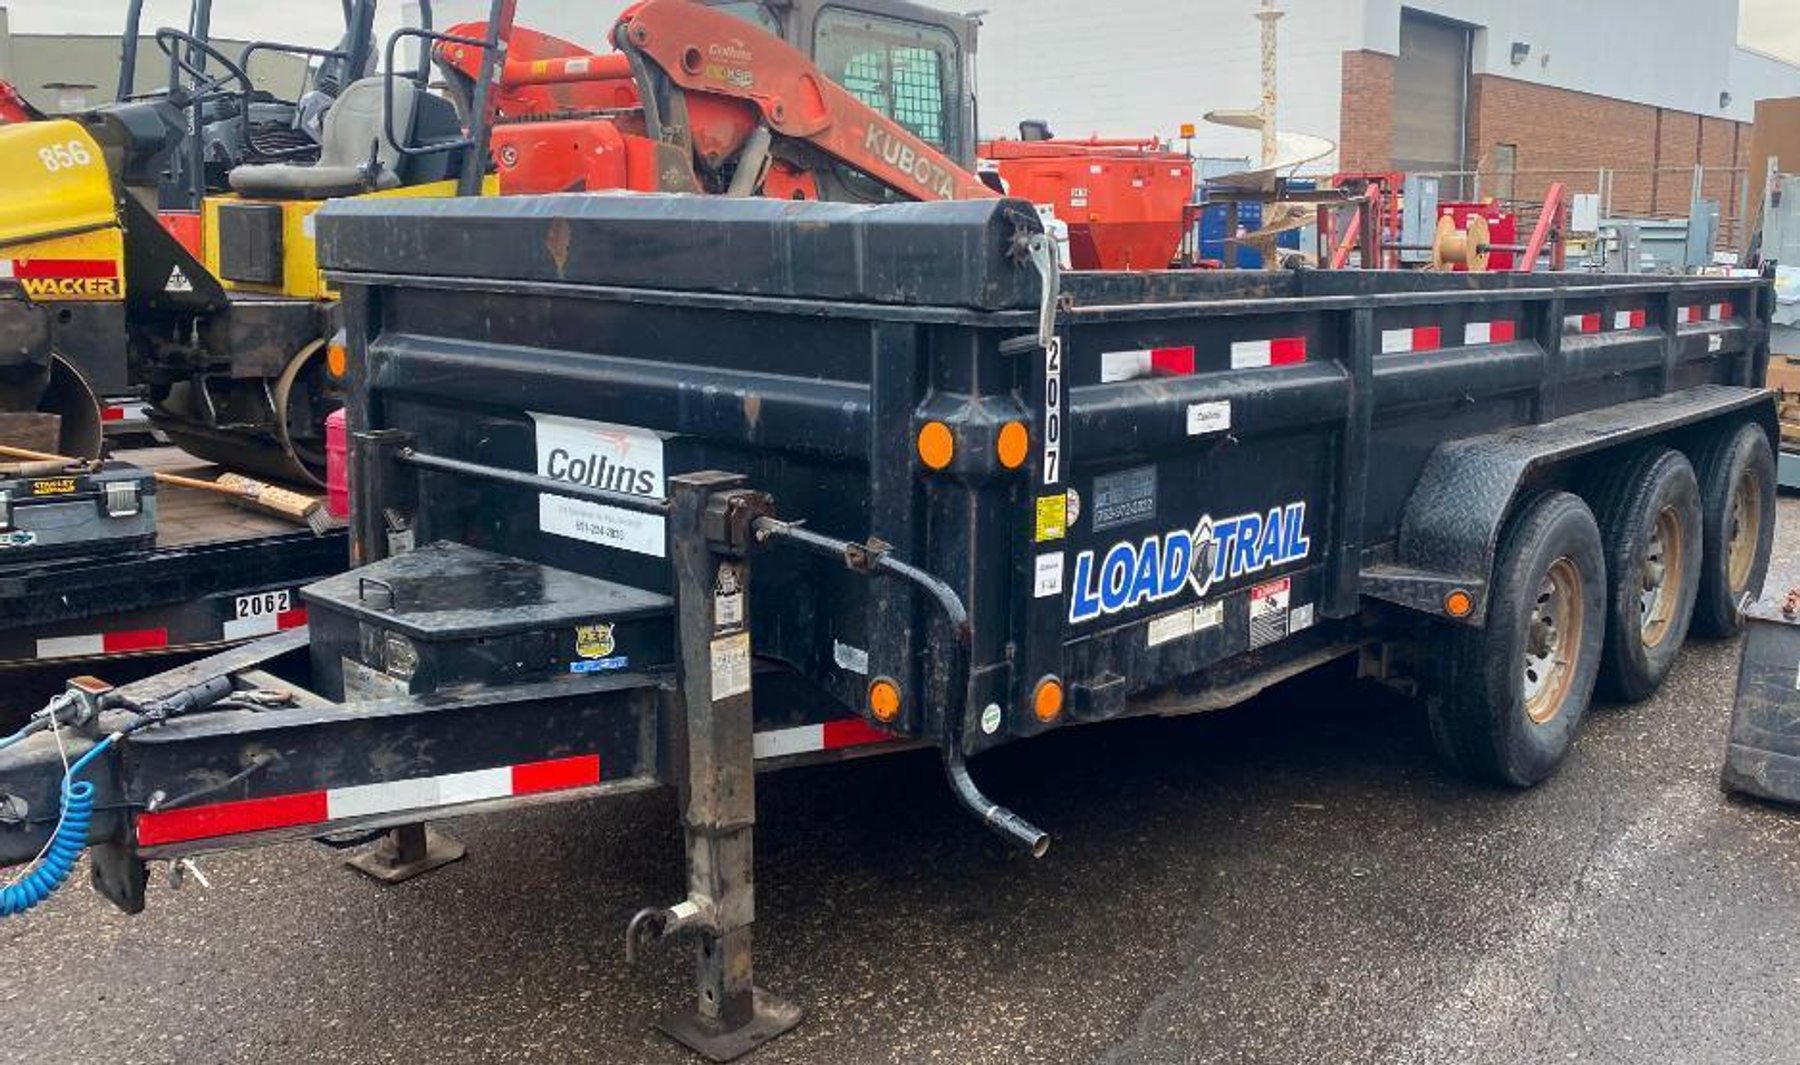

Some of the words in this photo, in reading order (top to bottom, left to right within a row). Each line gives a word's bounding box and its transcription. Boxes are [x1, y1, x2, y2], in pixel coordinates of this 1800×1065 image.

[38, 140, 91, 172] 856
[864, 122, 954, 201] KUBOTA
[21, 278, 115, 294] WACKER
[1046, 338, 1060, 482] 2007
[546, 448, 656, 495] Collins
[1069, 530, 1194, 623] LOAD
[1209, 501, 1311, 583] TRAIL
[239, 593, 288, 618] 2062
